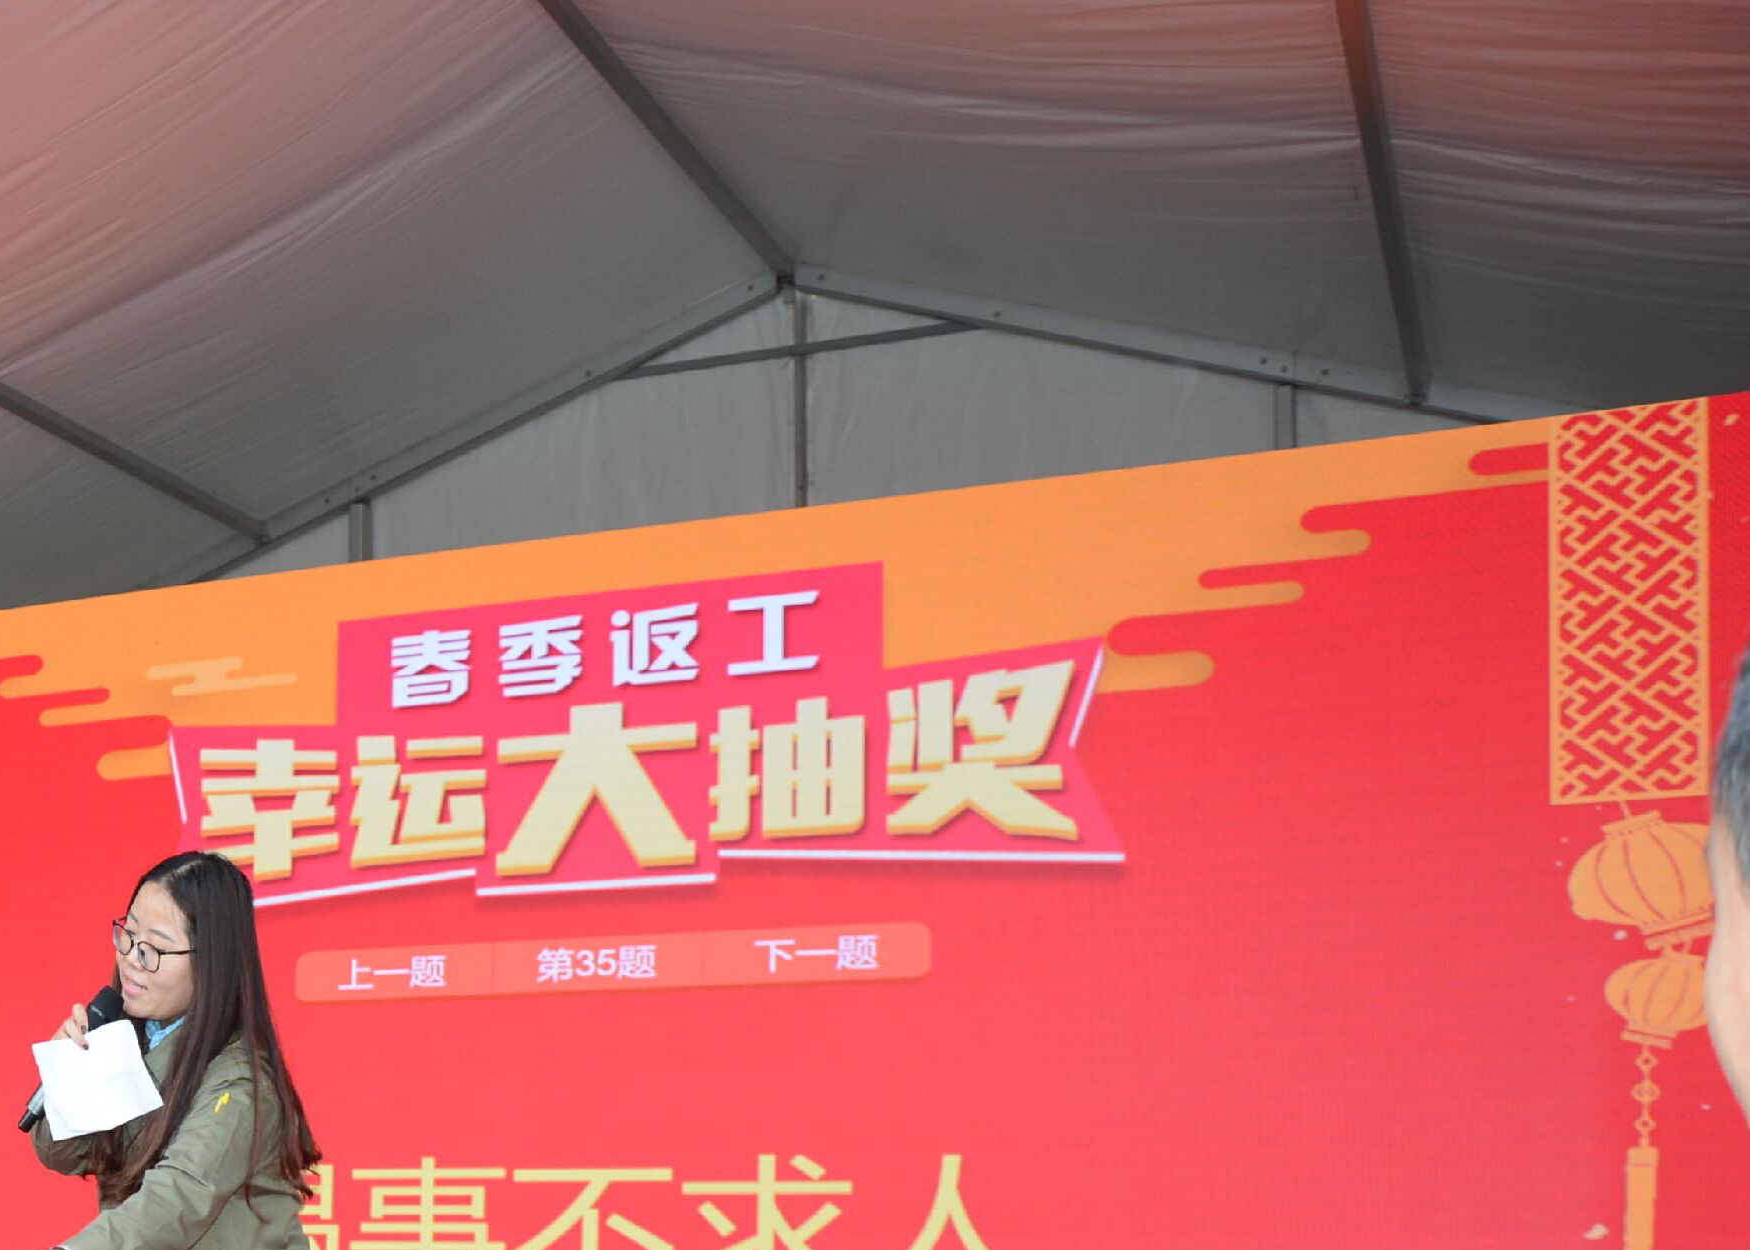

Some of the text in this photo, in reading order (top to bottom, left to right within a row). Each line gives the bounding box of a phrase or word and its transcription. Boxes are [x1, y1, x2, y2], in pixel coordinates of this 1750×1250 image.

[389, 589, 820, 709] 春季返工
[199, 659, 1080, 880] 幸运大抽奖
[336, 954, 447, 990] 上一题
[535, 944, 658, 981] 第35题
[754, 934, 879, 973] 下一题
